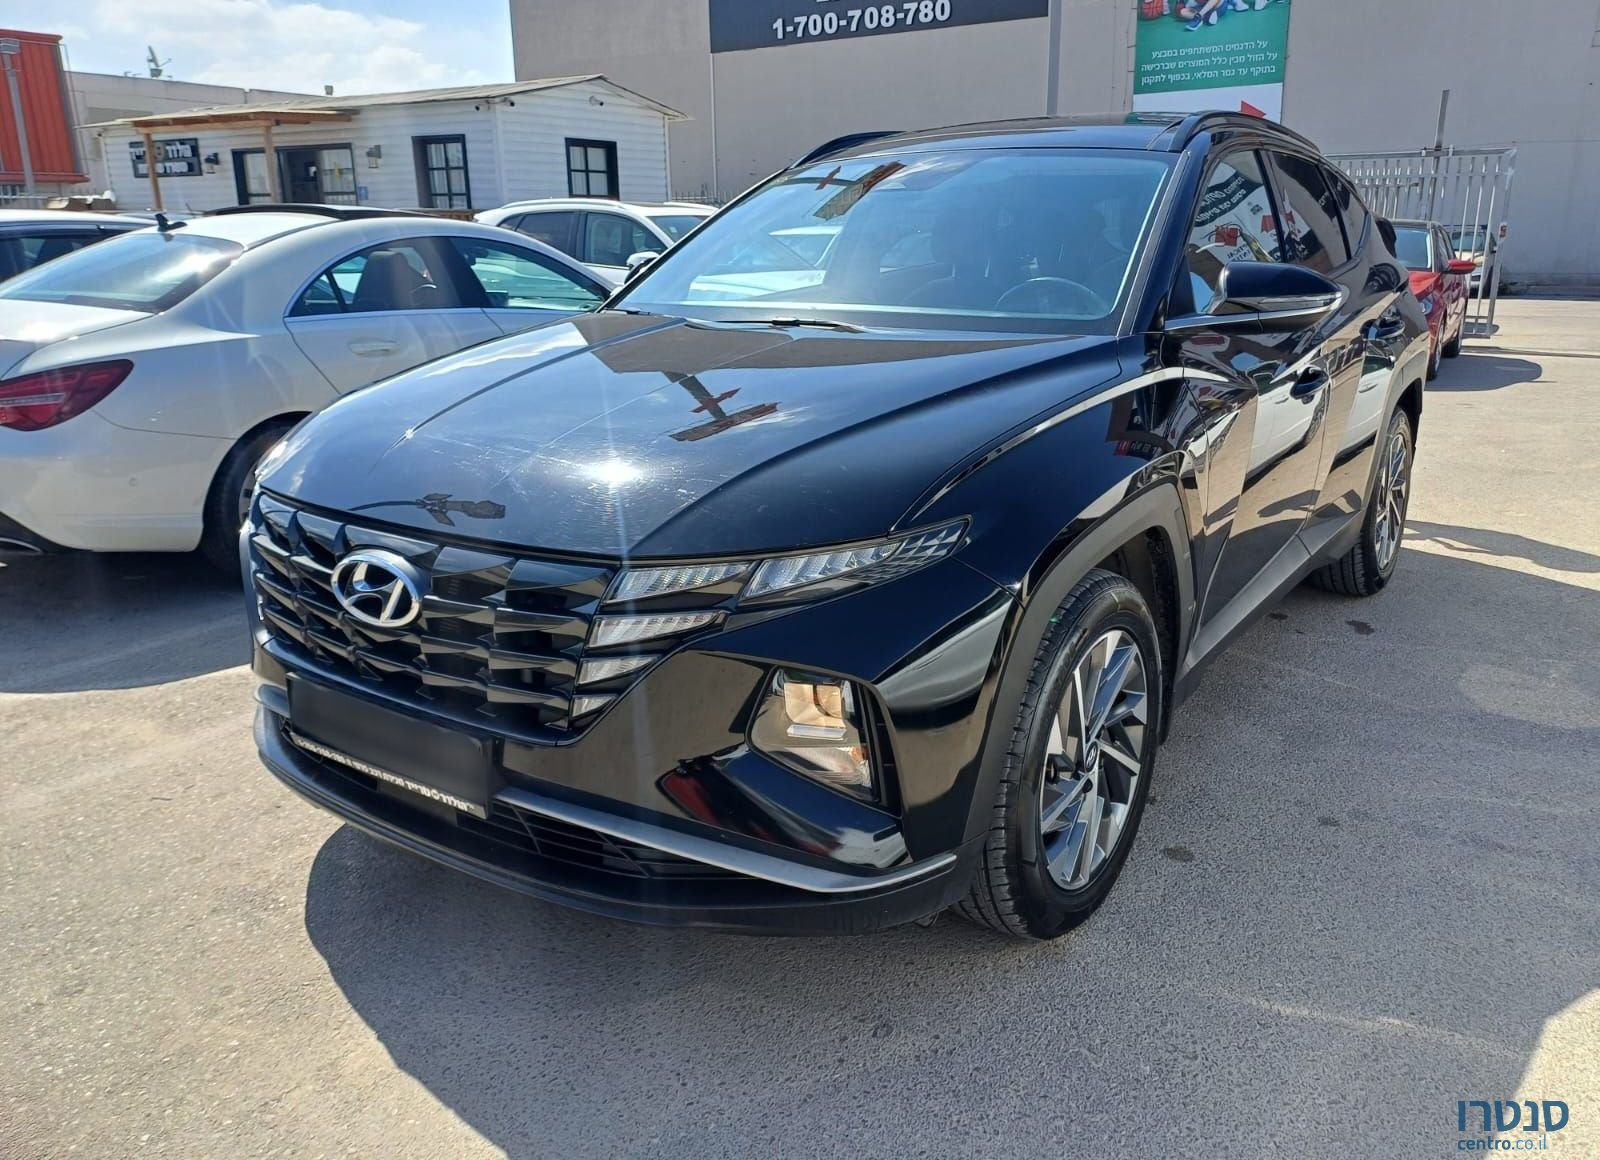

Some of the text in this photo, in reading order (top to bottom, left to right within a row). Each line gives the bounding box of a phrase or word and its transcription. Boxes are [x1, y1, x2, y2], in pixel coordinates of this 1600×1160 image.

[772, 0, 951, 39] 1-700-708-780
[1151, 40, 1268, 59] על הדגמים המשתתפים במבצע
[1212, 56, 1227, 65] כלל
[1266, 52, 1278, 61] על
[1178, 58, 1210, 68] המוצרים
[1221, 68, 1235, 77] גמר
[1238, 67, 1248, 76] עד
[1250, 65, 1276, 76] בתוקף
[1141, 74, 1167, 86] לתקנון
[1168, 72, 1191, 83] בכפוף
